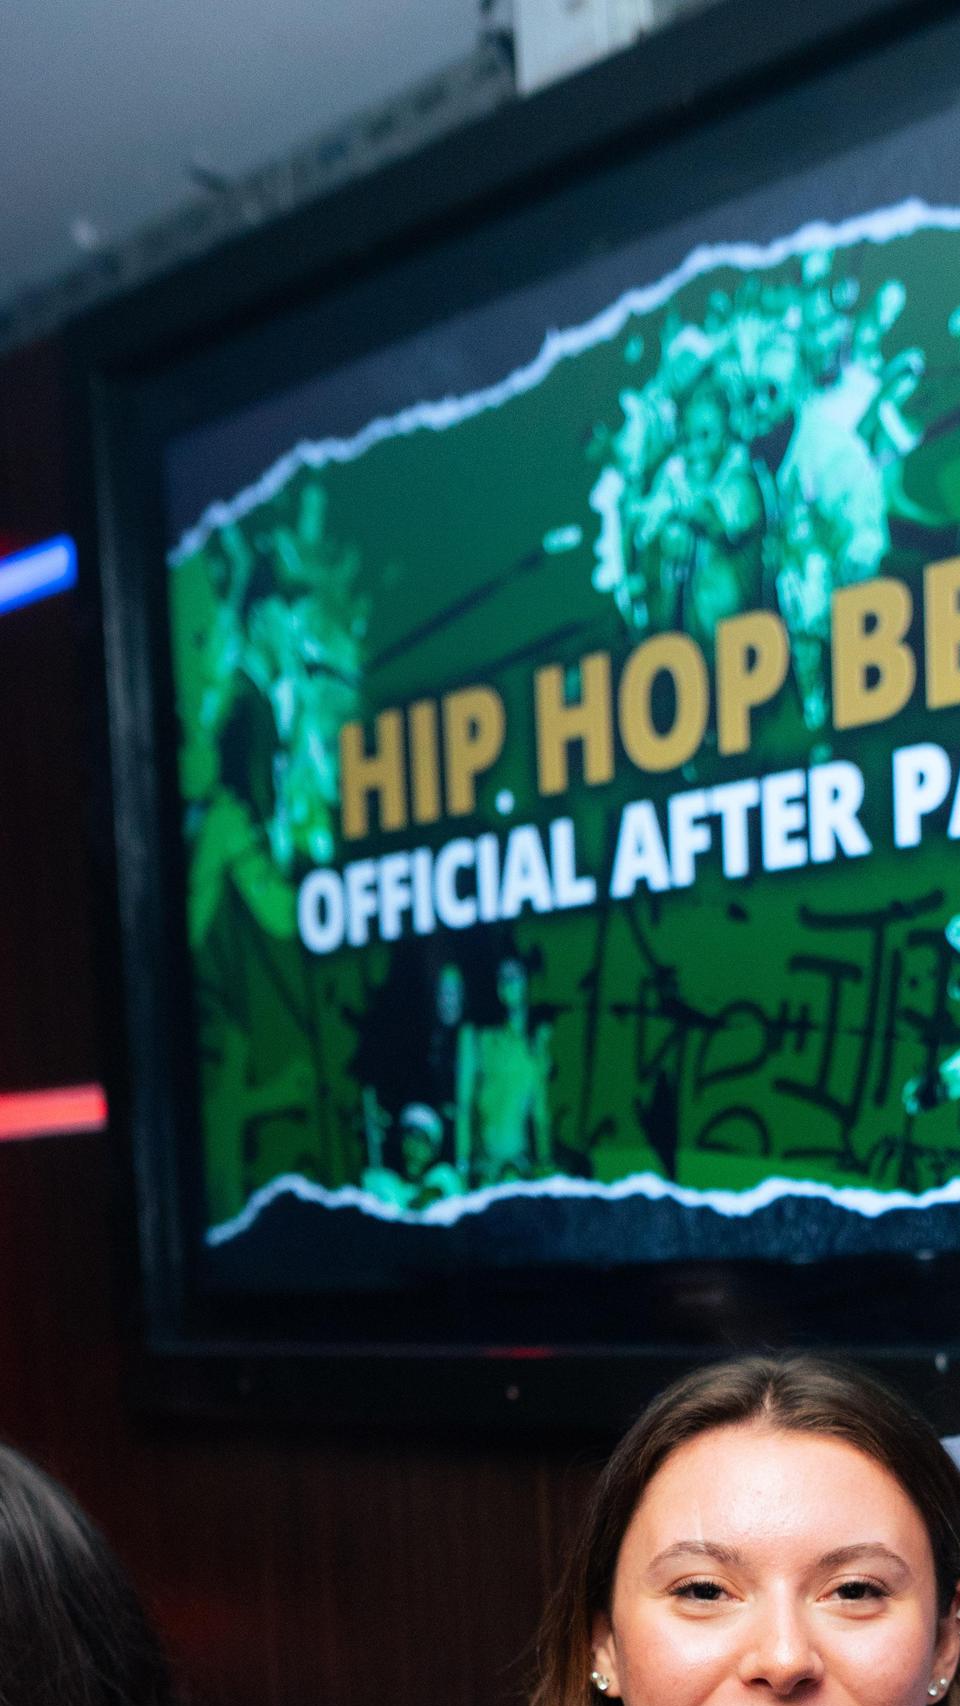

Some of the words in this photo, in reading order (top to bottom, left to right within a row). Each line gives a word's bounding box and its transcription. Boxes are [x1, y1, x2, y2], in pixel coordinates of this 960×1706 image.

[339, 686, 504, 838] HIP
[535, 612, 788, 794] HOP
[298, 817, 595, 953] OFFICIAL
[611, 761, 870, 897] AFTER
